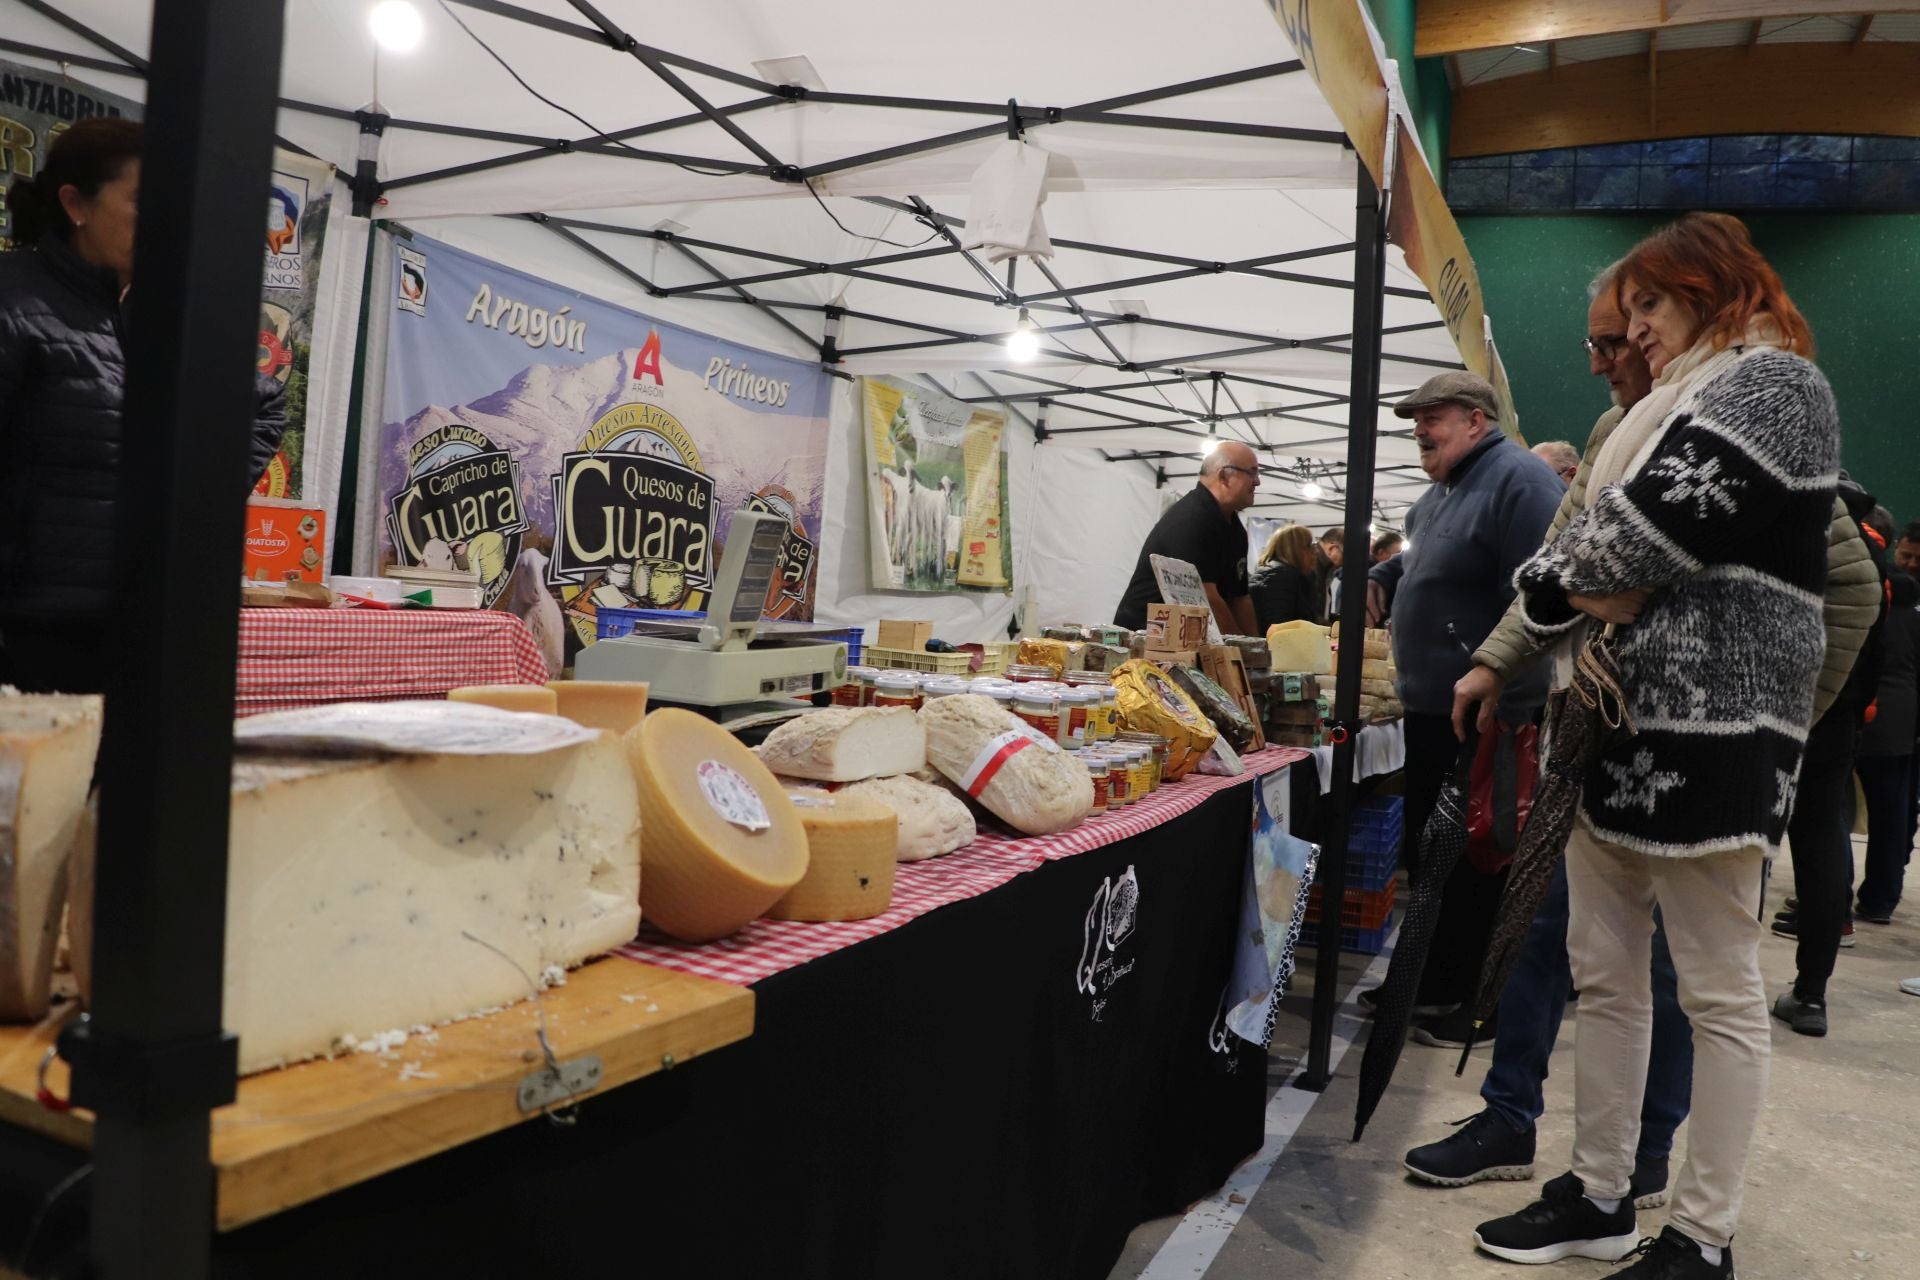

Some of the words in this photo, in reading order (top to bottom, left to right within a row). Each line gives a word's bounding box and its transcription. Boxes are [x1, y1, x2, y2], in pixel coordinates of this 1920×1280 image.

[465, 283, 586, 354] Aragón
[704, 356, 791, 408] Pirineos
[409, 432, 440, 465] ueso
[441, 425, 488, 448] Curado
[584, 409, 636, 458] Quesos
[640, 404, 699, 472] Artesanos
[429, 463, 488, 496] Capricho
[491, 457, 508, 476] de
[623, 466, 684, 501] Quesos
[687, 482, 706, 510] de
[400, 484, 517, 562] Guara
[565, 459, 708, 573] Guara
[246, 537, 287, 548] DIATOSTA
[790, 542, 809, 561] de
